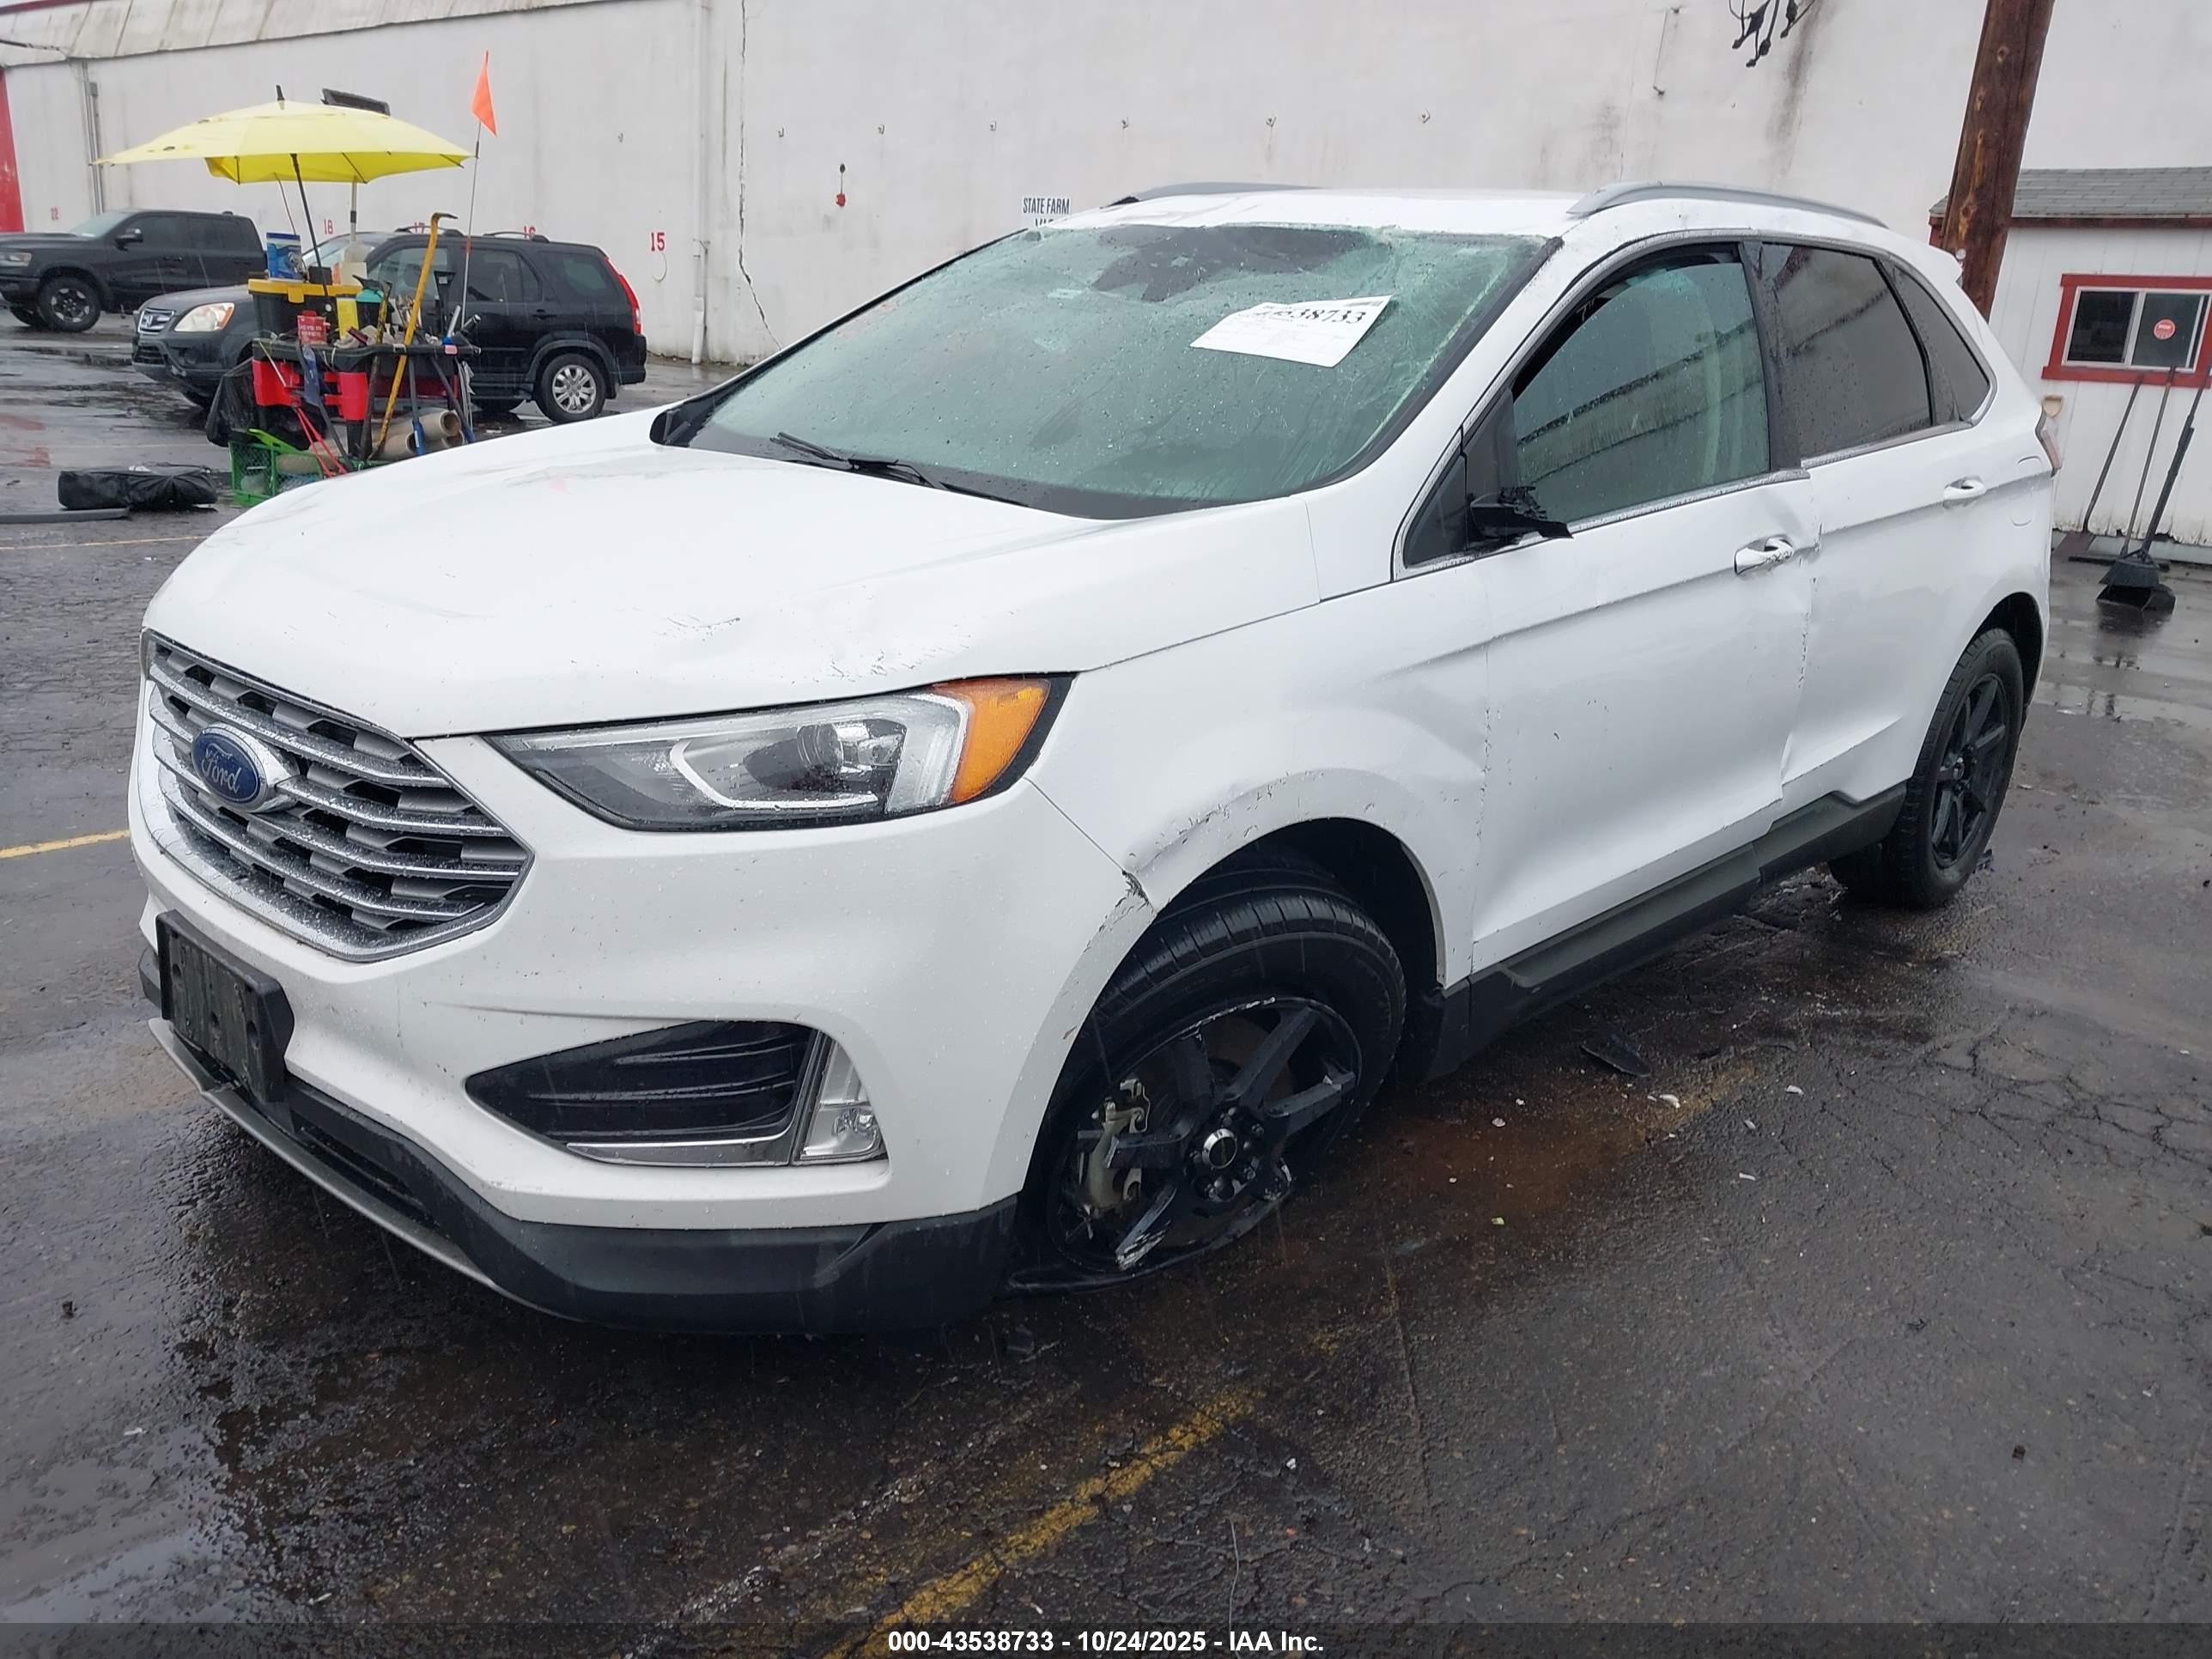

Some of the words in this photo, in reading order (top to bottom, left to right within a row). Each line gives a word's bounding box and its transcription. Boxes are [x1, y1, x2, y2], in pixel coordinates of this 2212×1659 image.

[1023, 197, 1045, 214] STATE
[1047, 198, 1070, 215] FARM
[324, 219, 334, 234] 18
[651, 231, 665, 252] 15
[201, 742, 242, 794] Ford
